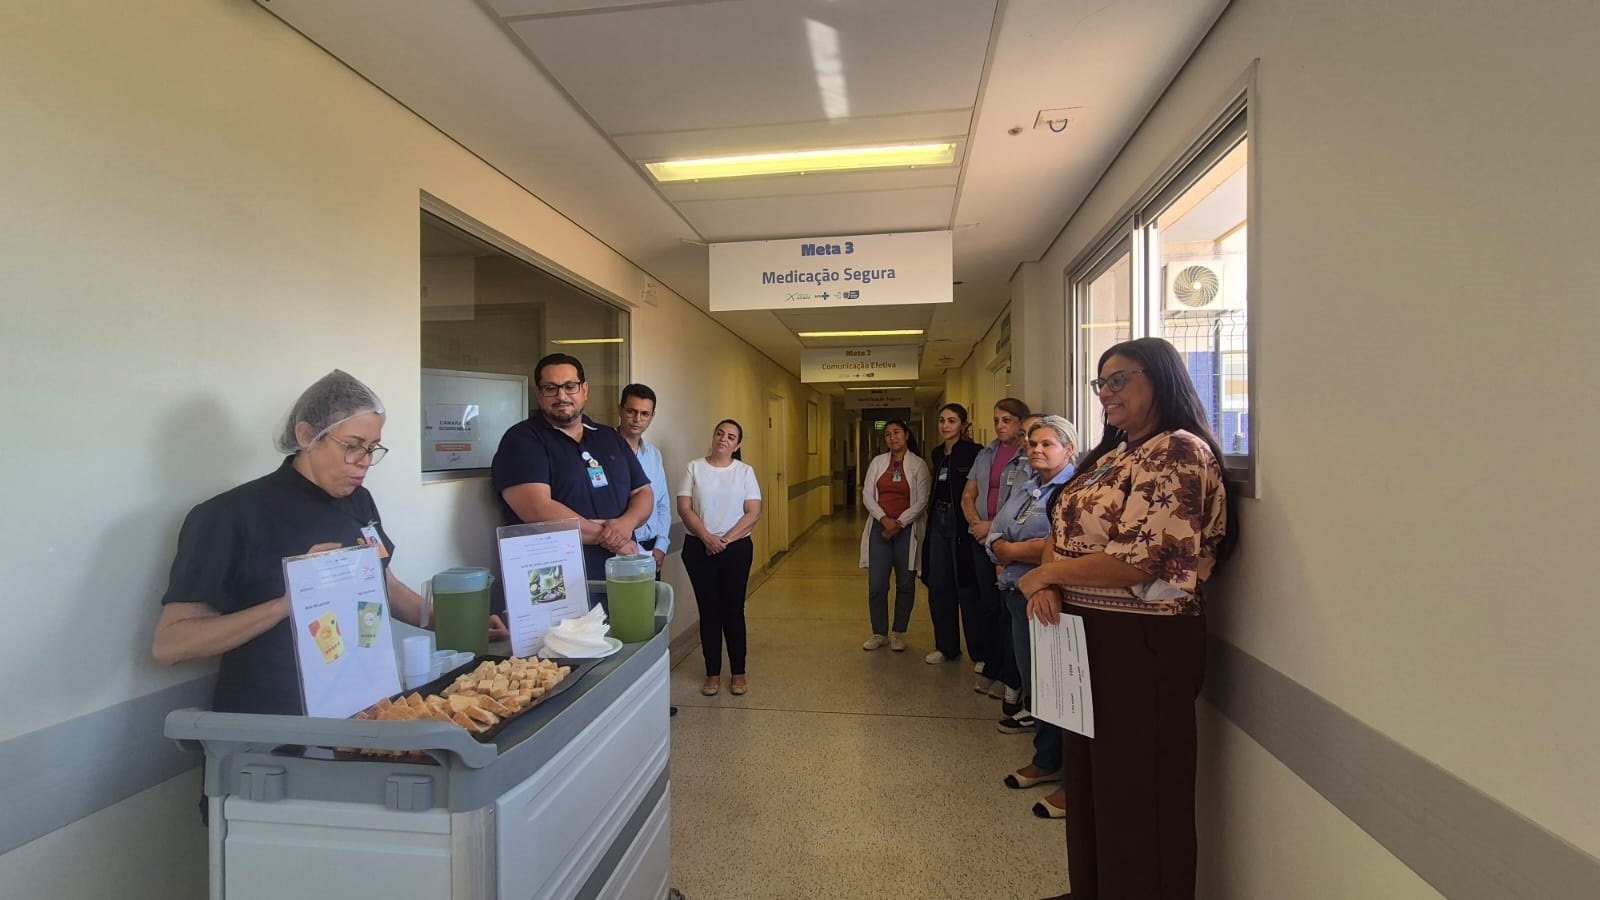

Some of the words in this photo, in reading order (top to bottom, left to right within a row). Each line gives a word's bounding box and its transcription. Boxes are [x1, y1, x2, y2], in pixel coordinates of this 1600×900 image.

[801, 243, 841, 256] Meta
[845, 241, 854, 254] 3
[762, 268, 840, 285] Medicação
[843, 268, 896, 283] Segura
[822, 362, 869, 371] Comunicação
[870, 361, 896, 369] Efetiva
